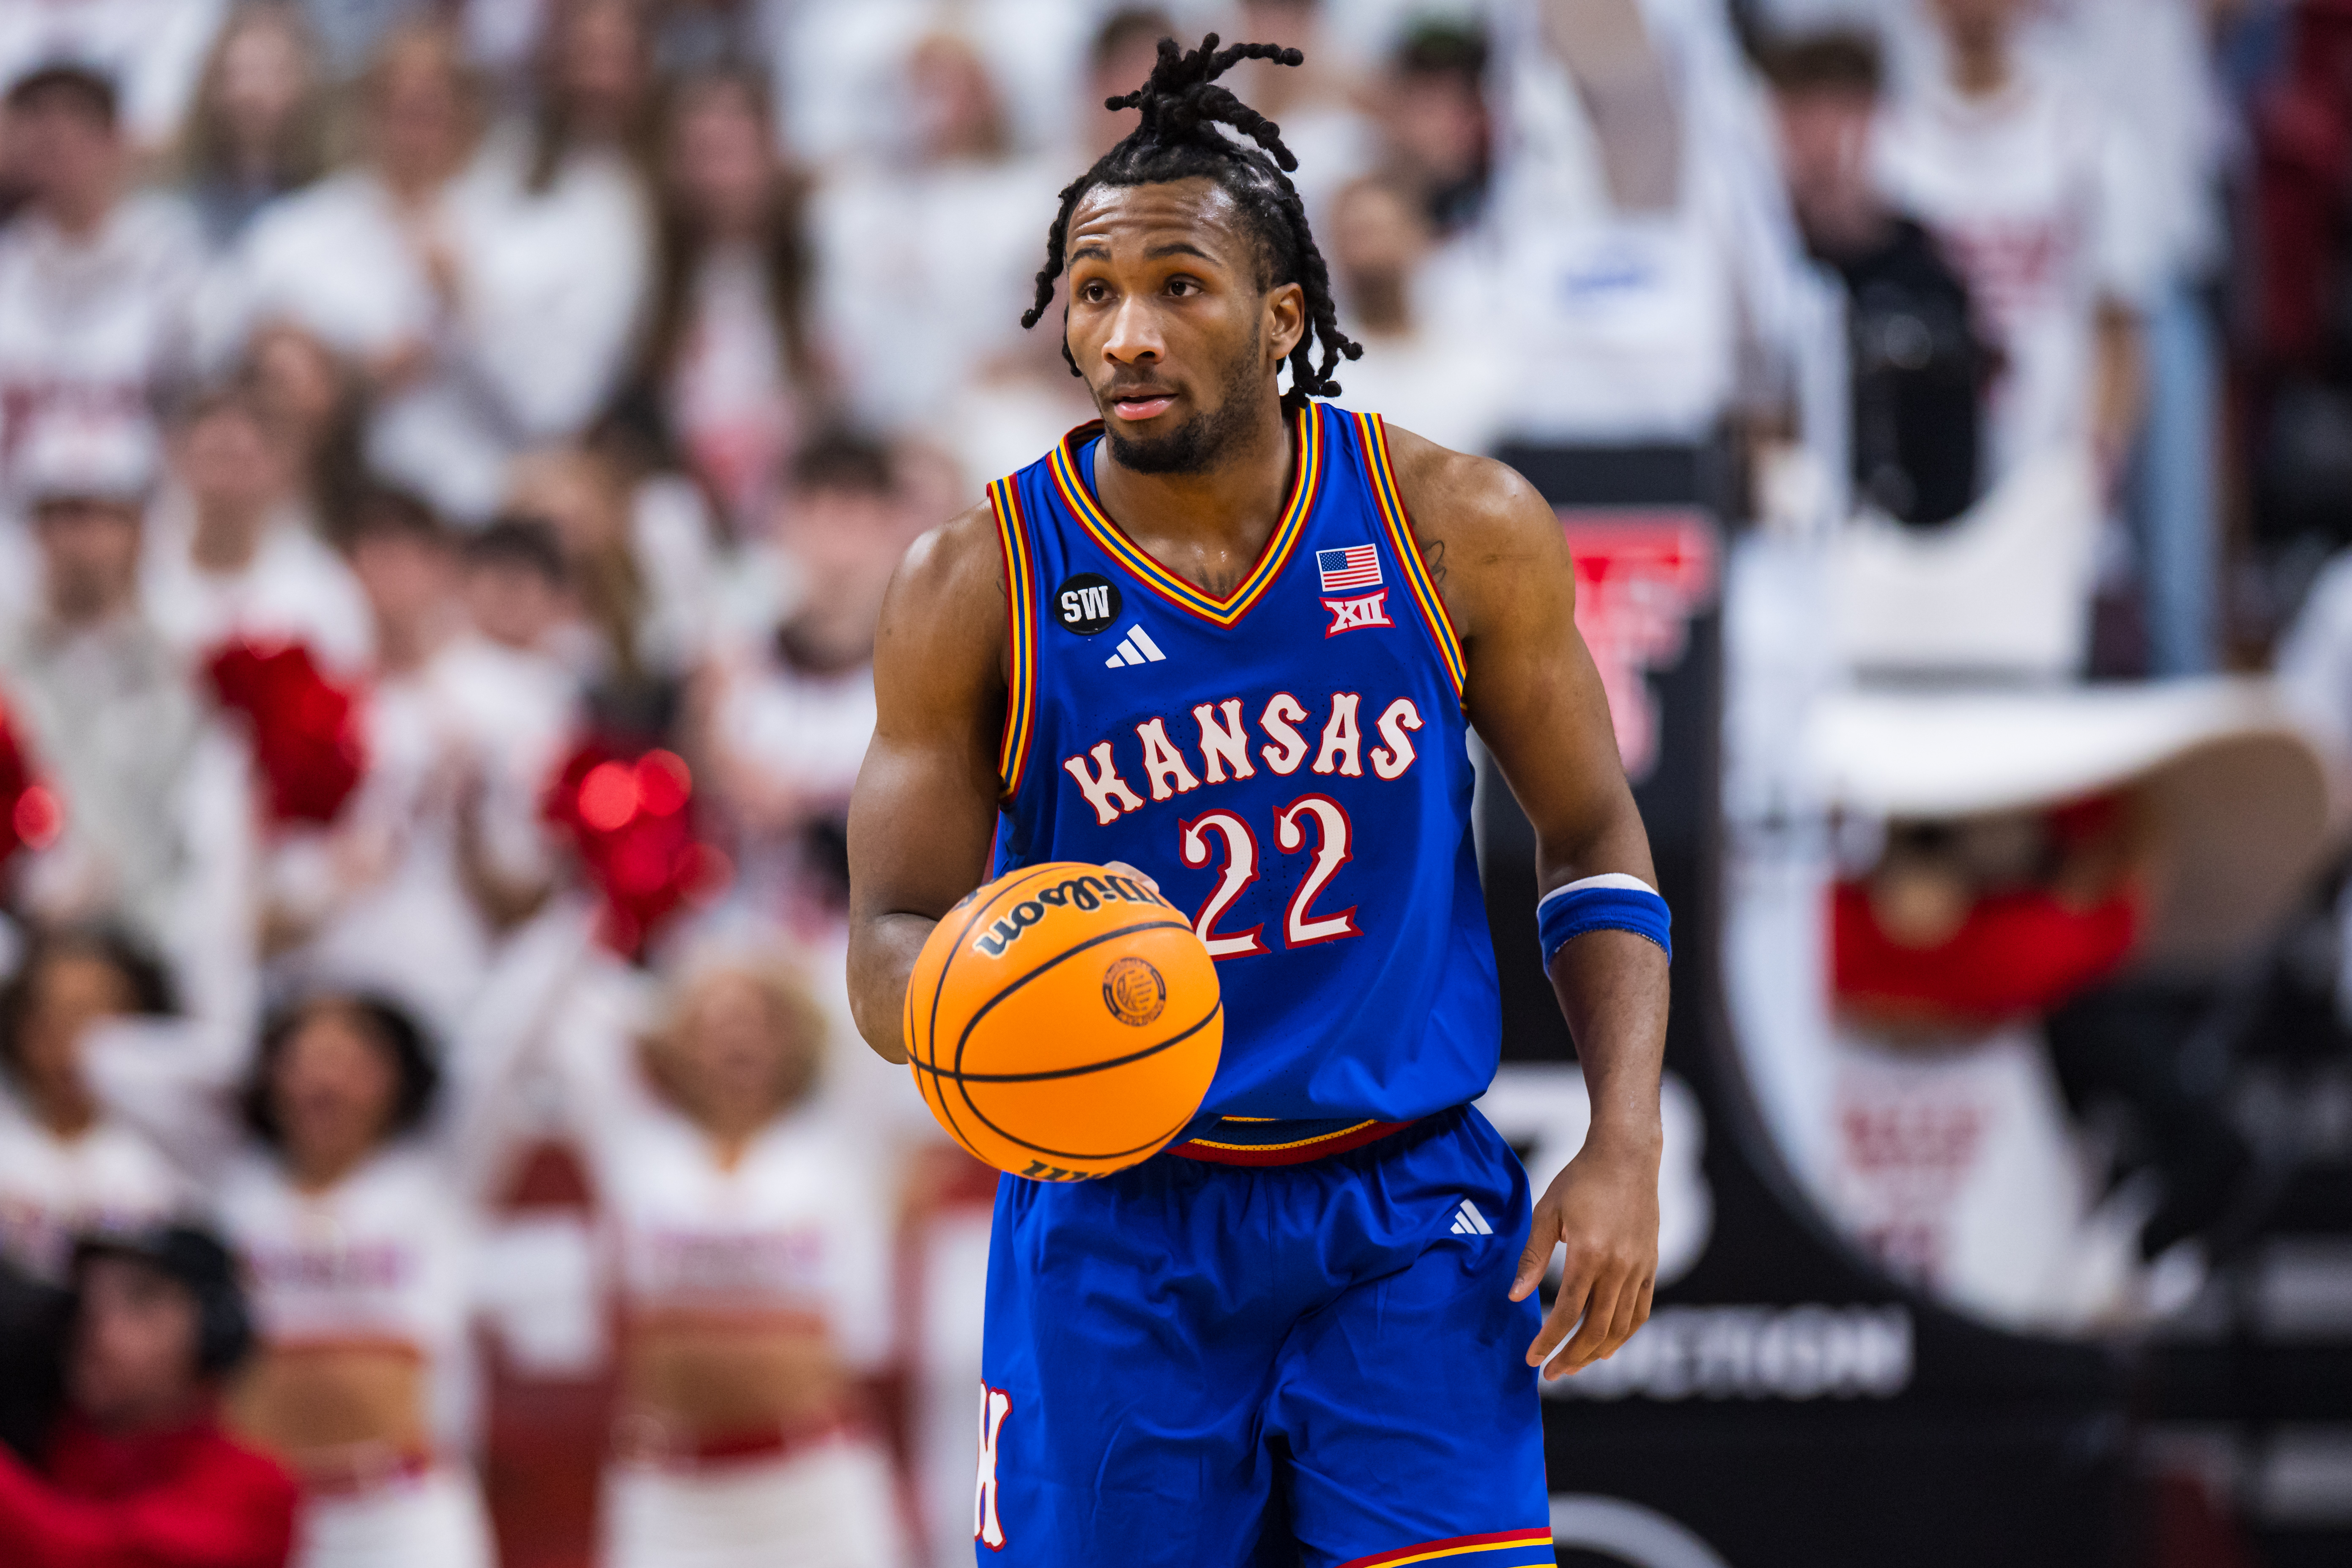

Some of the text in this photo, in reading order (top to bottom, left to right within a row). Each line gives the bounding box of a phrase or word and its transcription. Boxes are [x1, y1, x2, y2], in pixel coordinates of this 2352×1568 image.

[1061, 586, 1109, 623] SW
[1321, 589, 1394, 637] XII
[1062, 691, 1426, 826] KANSAS
[973, 873, 1170, 958] Wilson
[1178, 793, 1365, 961] 22
